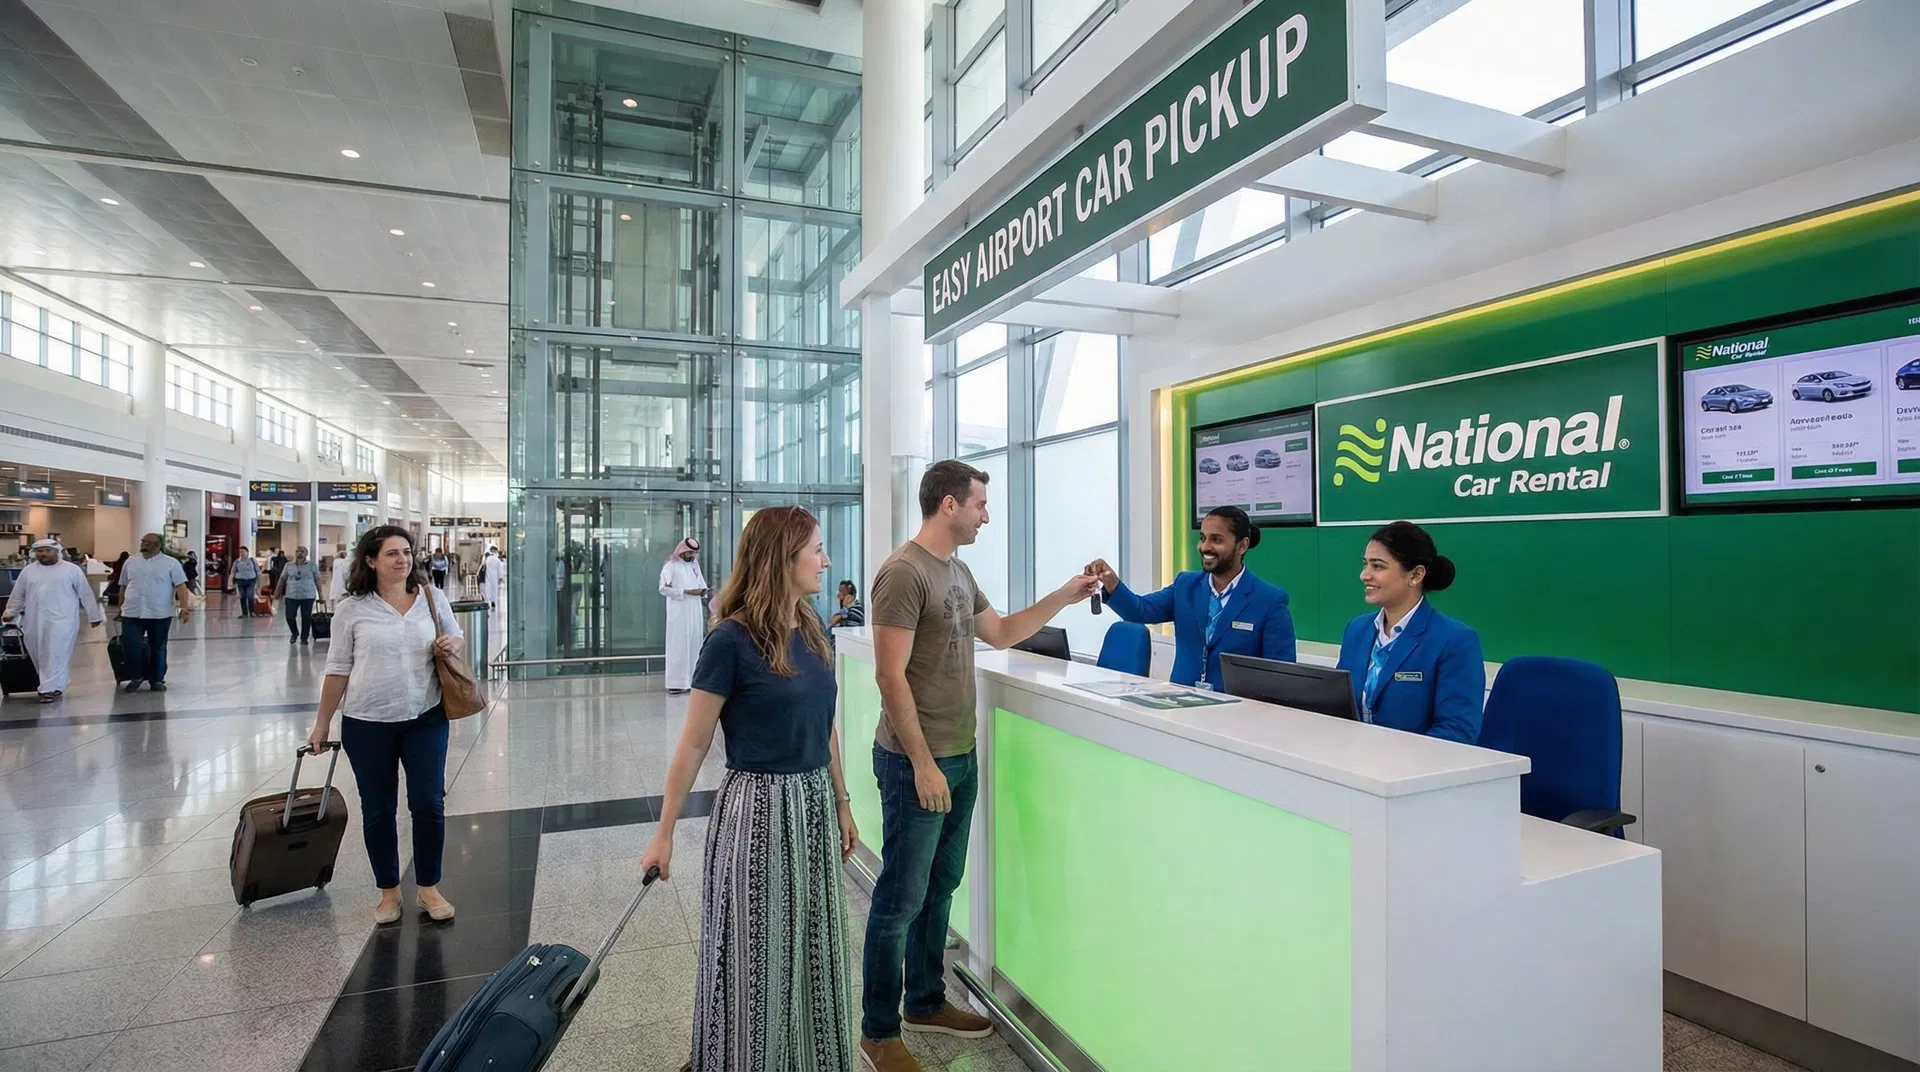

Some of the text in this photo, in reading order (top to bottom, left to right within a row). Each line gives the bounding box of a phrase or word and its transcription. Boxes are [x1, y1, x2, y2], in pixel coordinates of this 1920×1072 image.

[932, 13, 1308, 315] EASY AIRPORT CAR PICKUP
[1712, 336, 1769, 357] National
[1388, 394, 1623, 473] National
[1454, 461, 1611, 497] Car Rental
